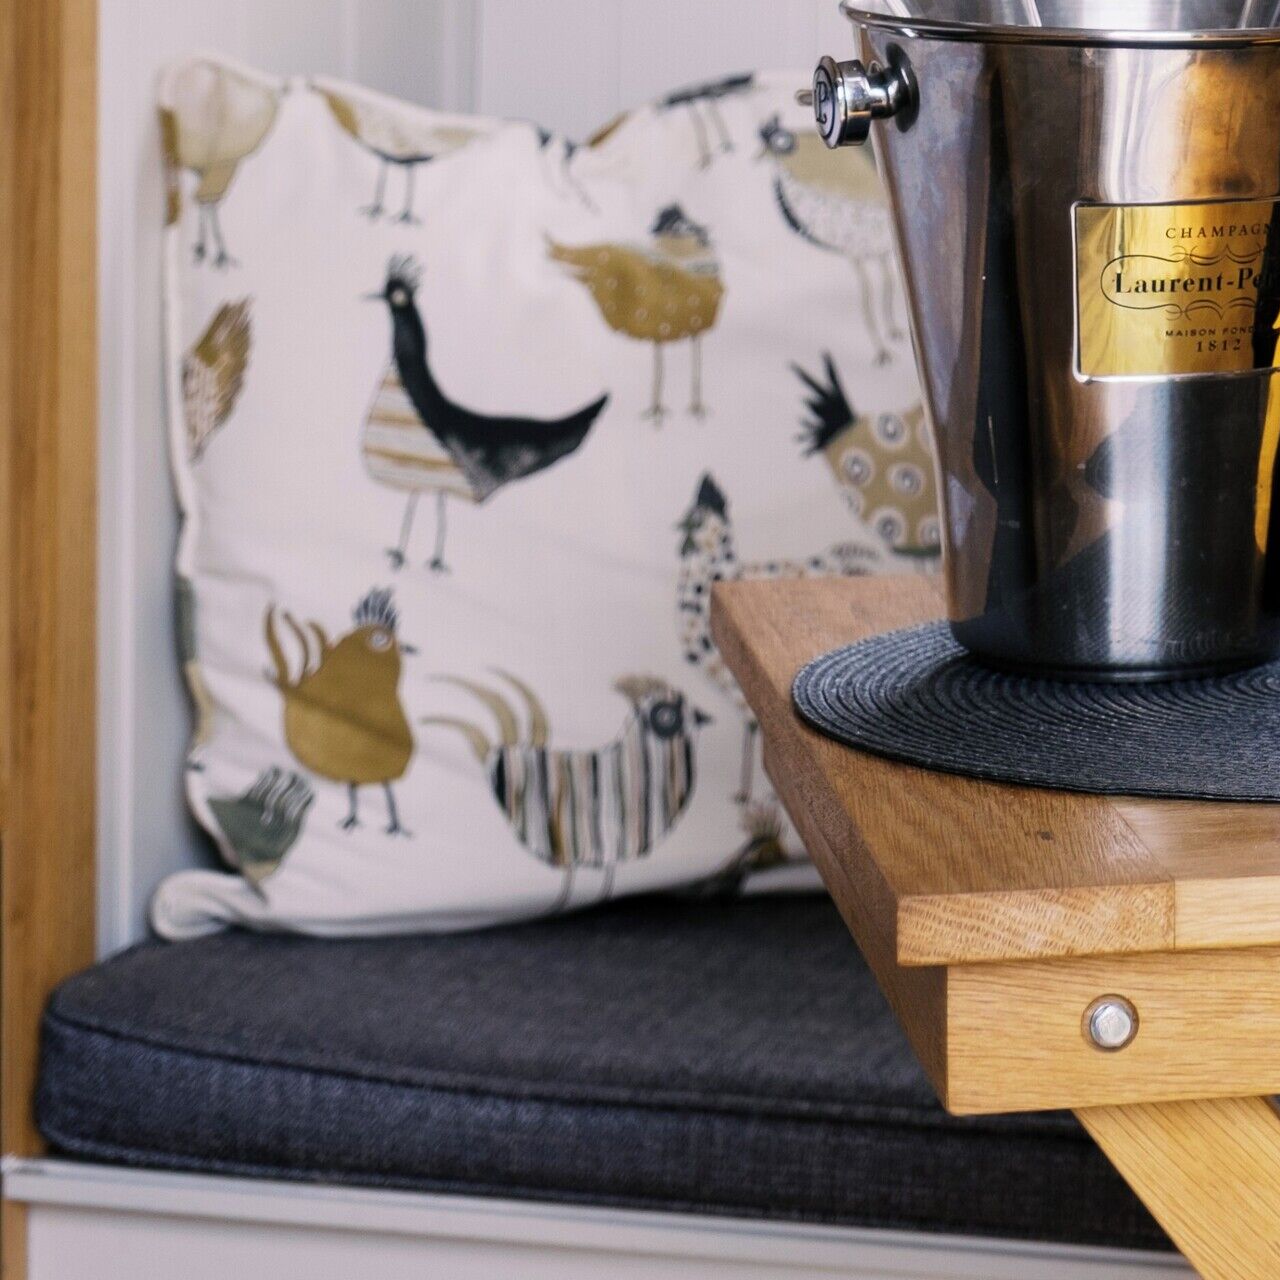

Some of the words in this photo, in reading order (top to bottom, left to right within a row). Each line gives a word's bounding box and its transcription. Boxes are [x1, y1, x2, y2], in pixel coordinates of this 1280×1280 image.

[1165, 223, 1273, 240] CHAMPAGN
[1165, 328, 1216, 337] MAISON
[1196, 338, 1241, 352] 1812
